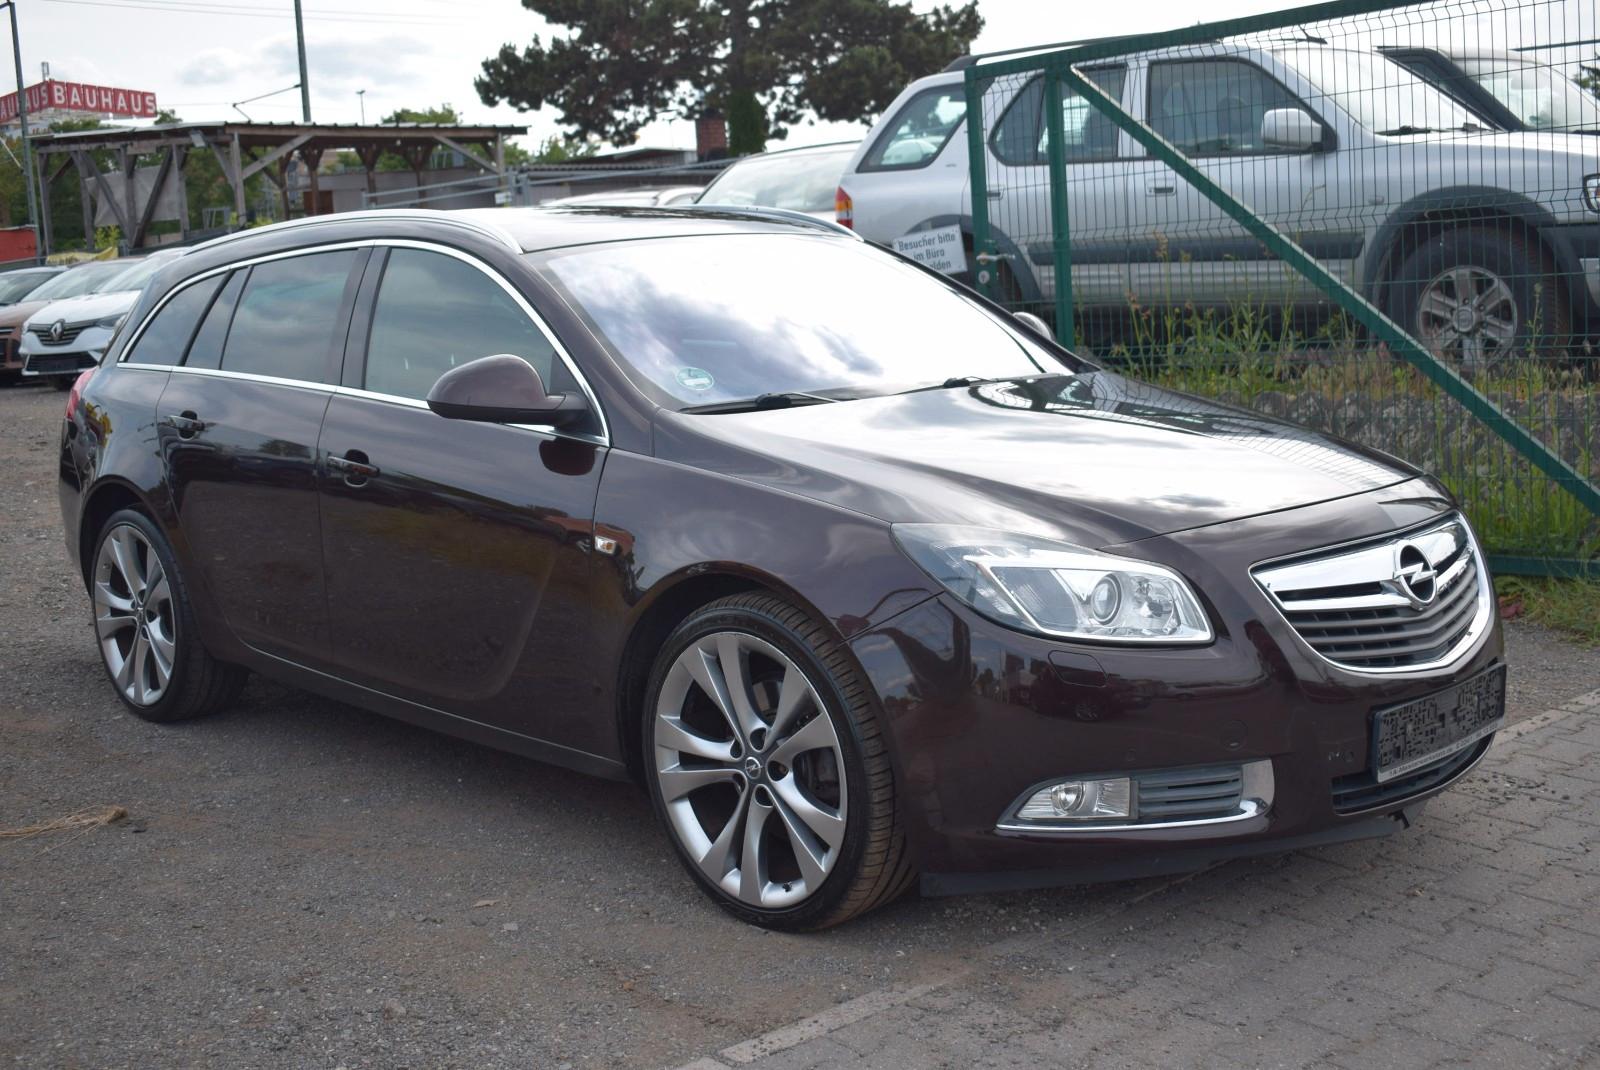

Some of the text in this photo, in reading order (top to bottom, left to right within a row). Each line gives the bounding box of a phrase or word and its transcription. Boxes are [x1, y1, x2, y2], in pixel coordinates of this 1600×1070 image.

[54, 85, 156, 113] BAUHAUS
[898, 232, 956, 251] Besucher bitte
[913, 248, 945, 261] im Büro
